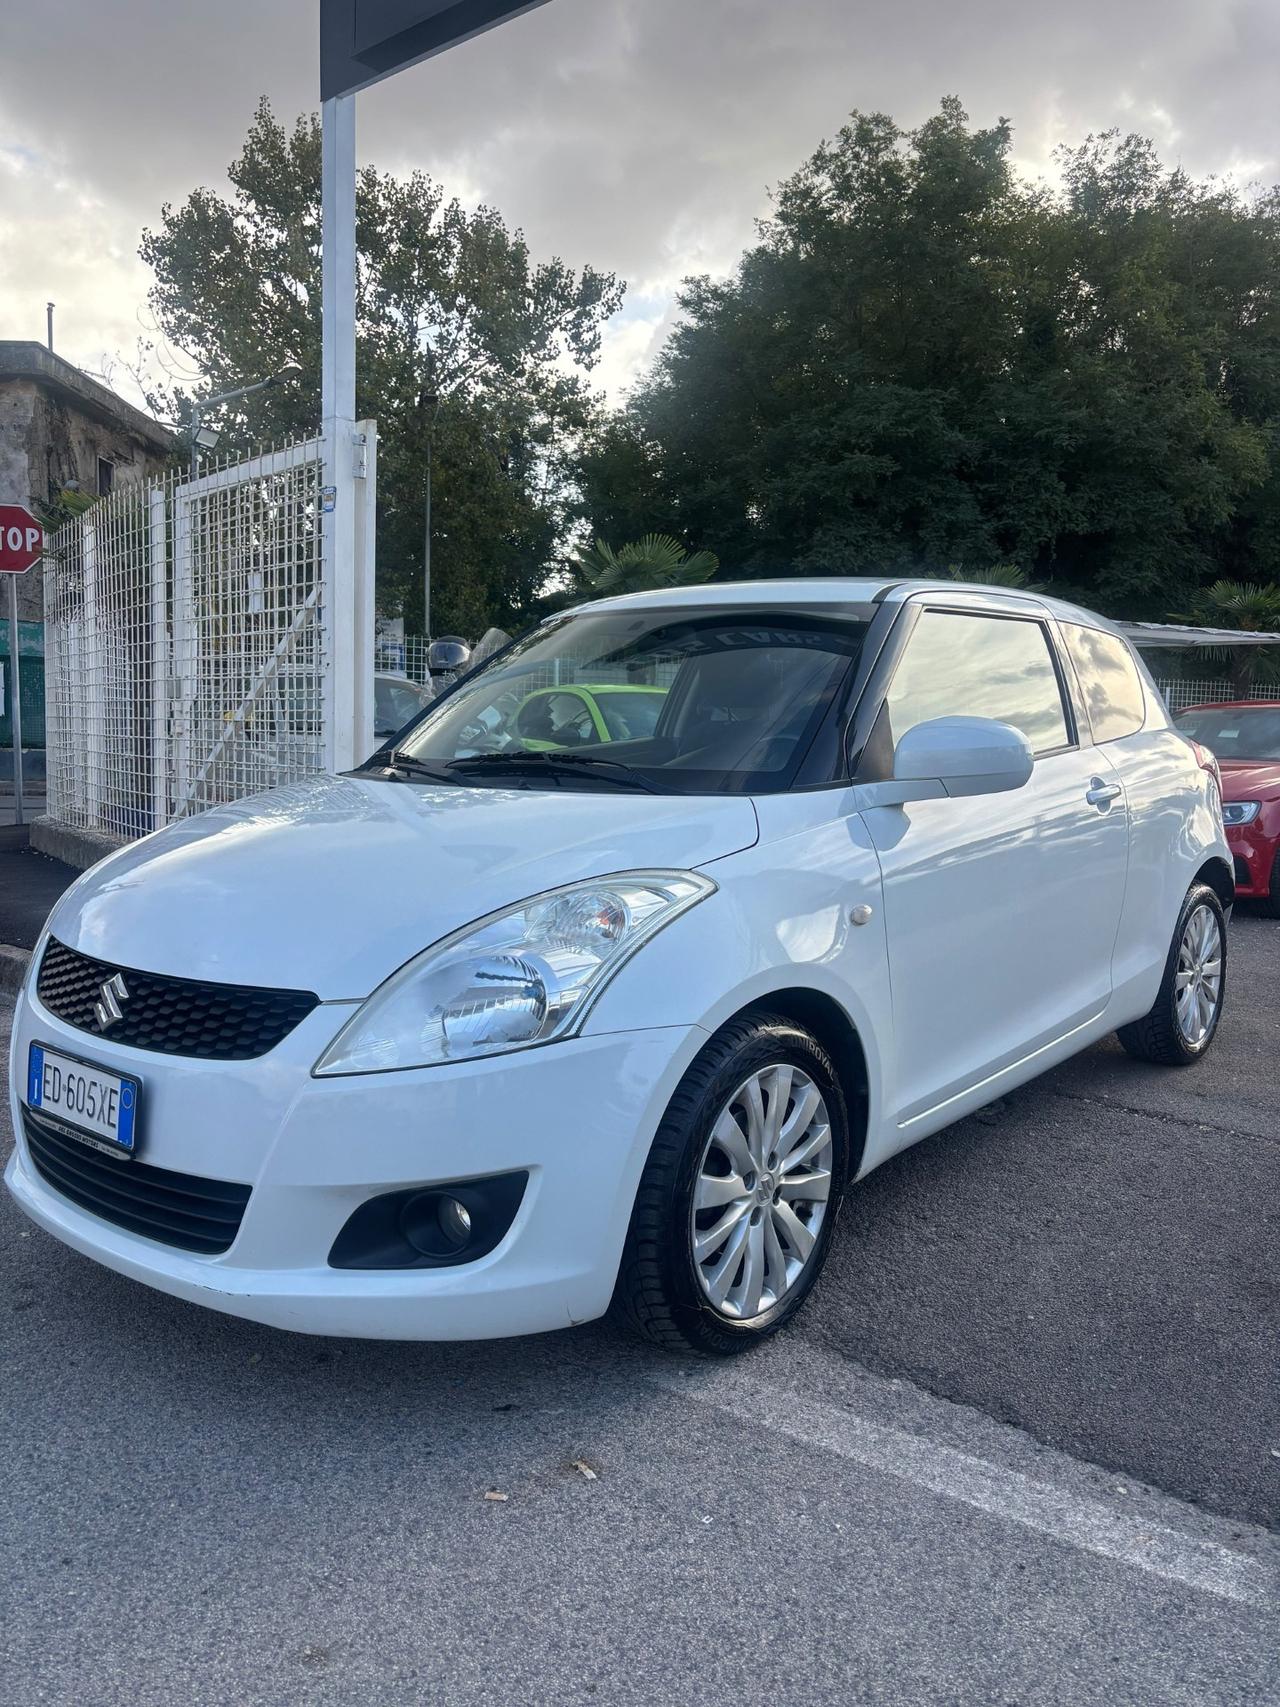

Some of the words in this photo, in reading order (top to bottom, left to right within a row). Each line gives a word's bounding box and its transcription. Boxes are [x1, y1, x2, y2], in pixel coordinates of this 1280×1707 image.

[791, 1036, 834, 1082] UNIROYAL
[43, 1063, 61, 1103] ED
[66, 1073, 118, 1128] 605XE
